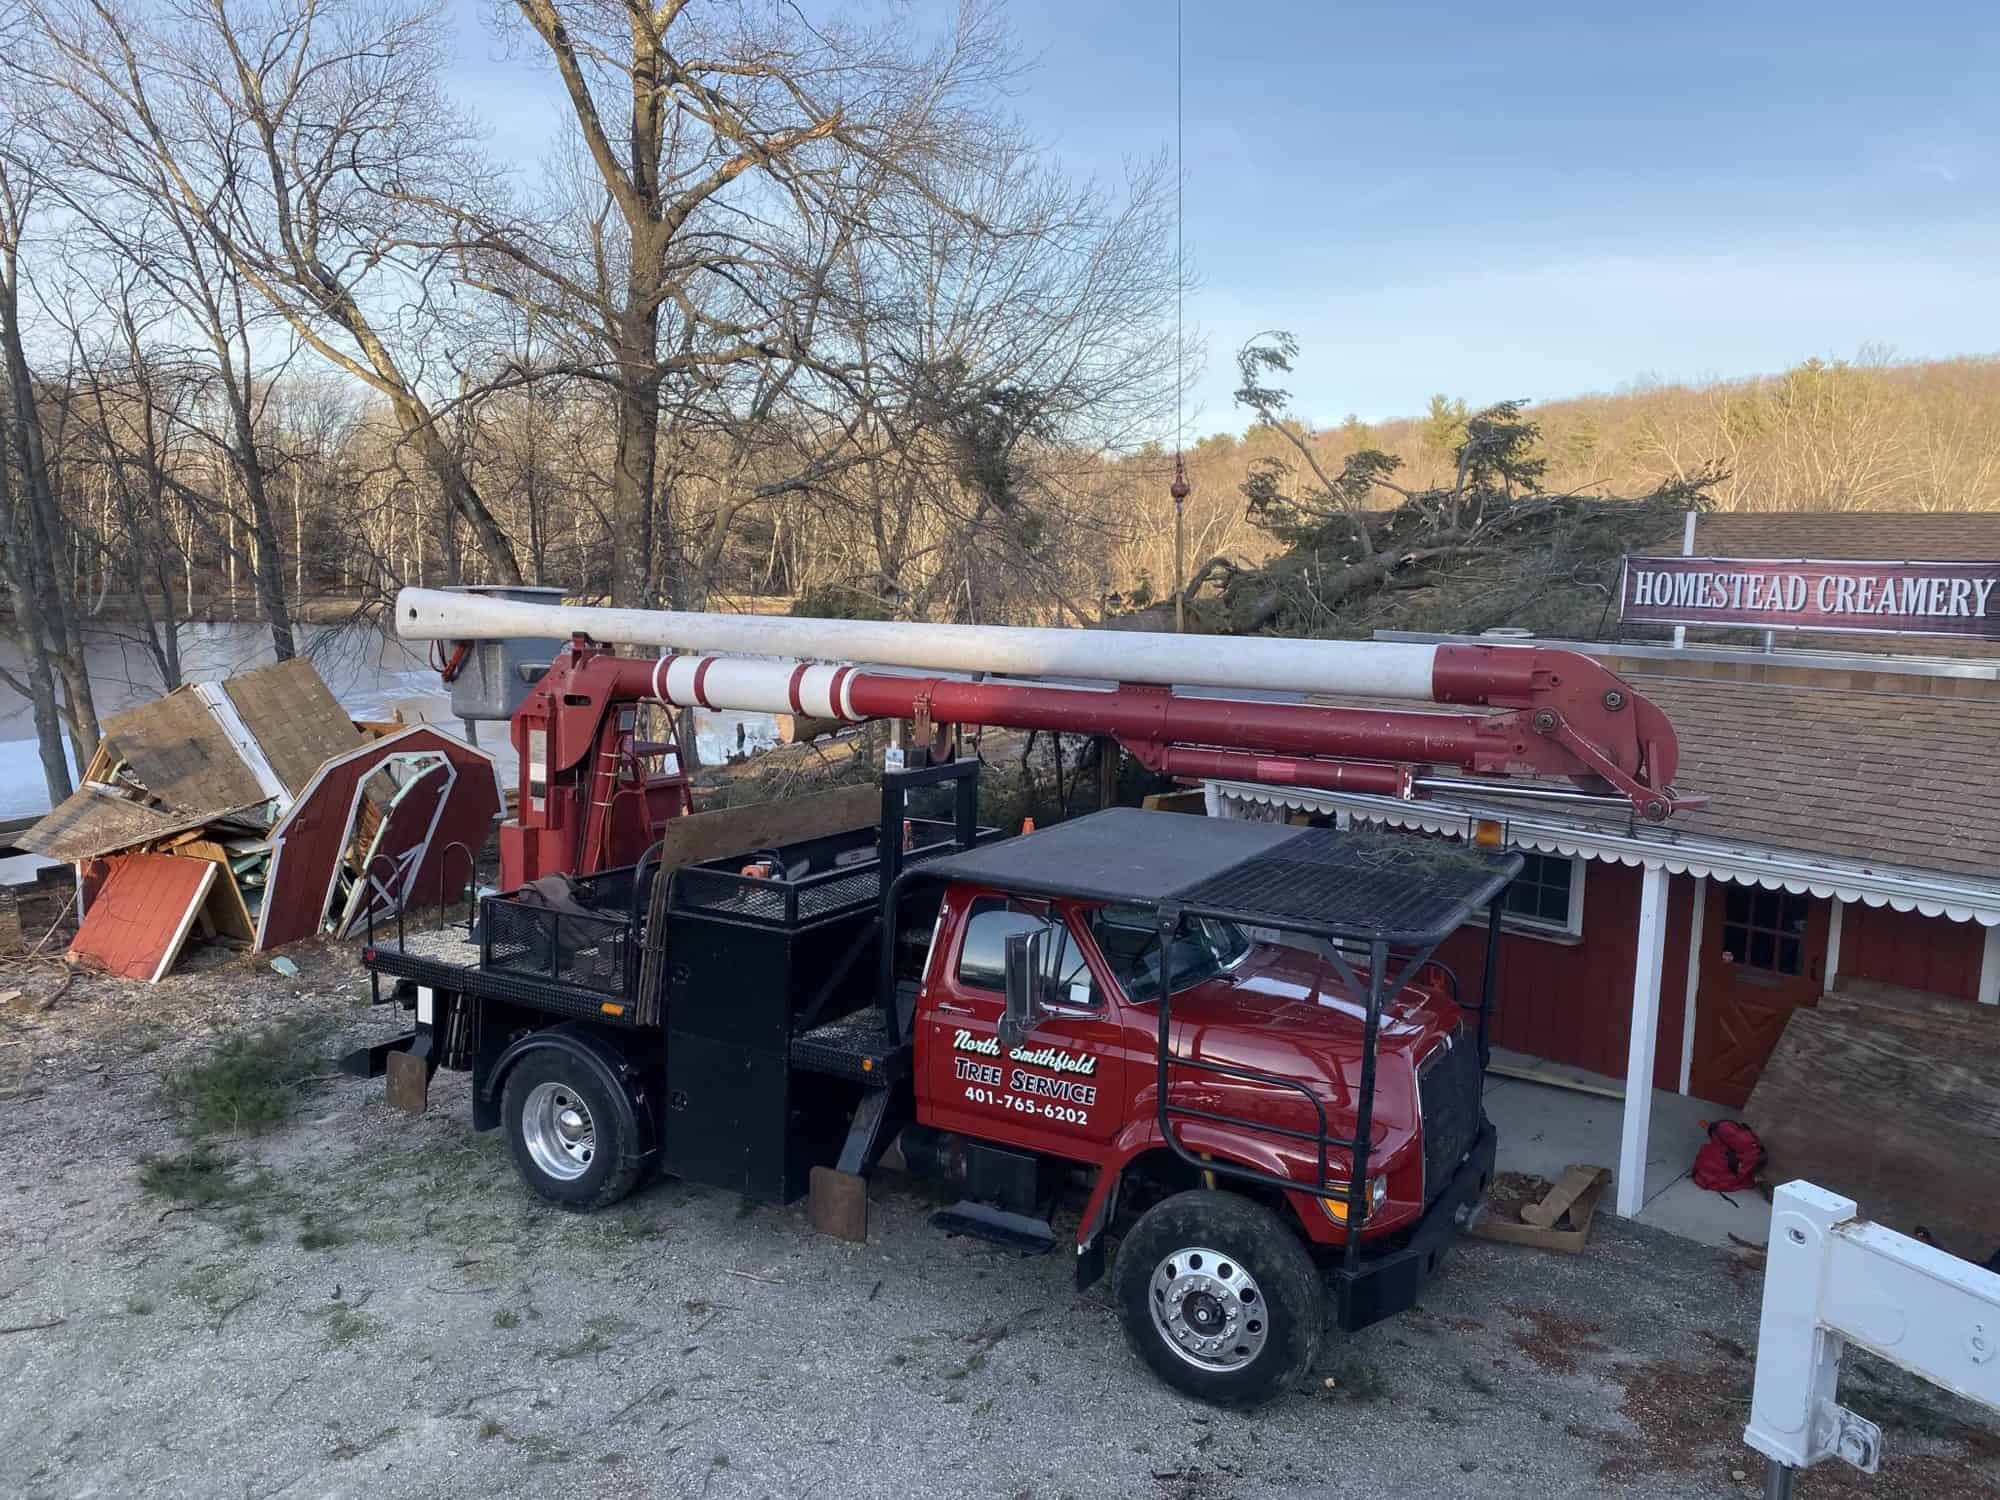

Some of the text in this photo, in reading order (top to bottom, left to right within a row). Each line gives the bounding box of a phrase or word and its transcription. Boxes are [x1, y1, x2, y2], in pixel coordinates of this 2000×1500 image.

[1634, 571, 1997, 617] HOMESTEAD CREAMERY
[953, 1029, 1001, 1057] North
[954, 1057, 1097, 1106] TREE SERVICE
[965, 1087, 1089, 1126] 401-765-6202
